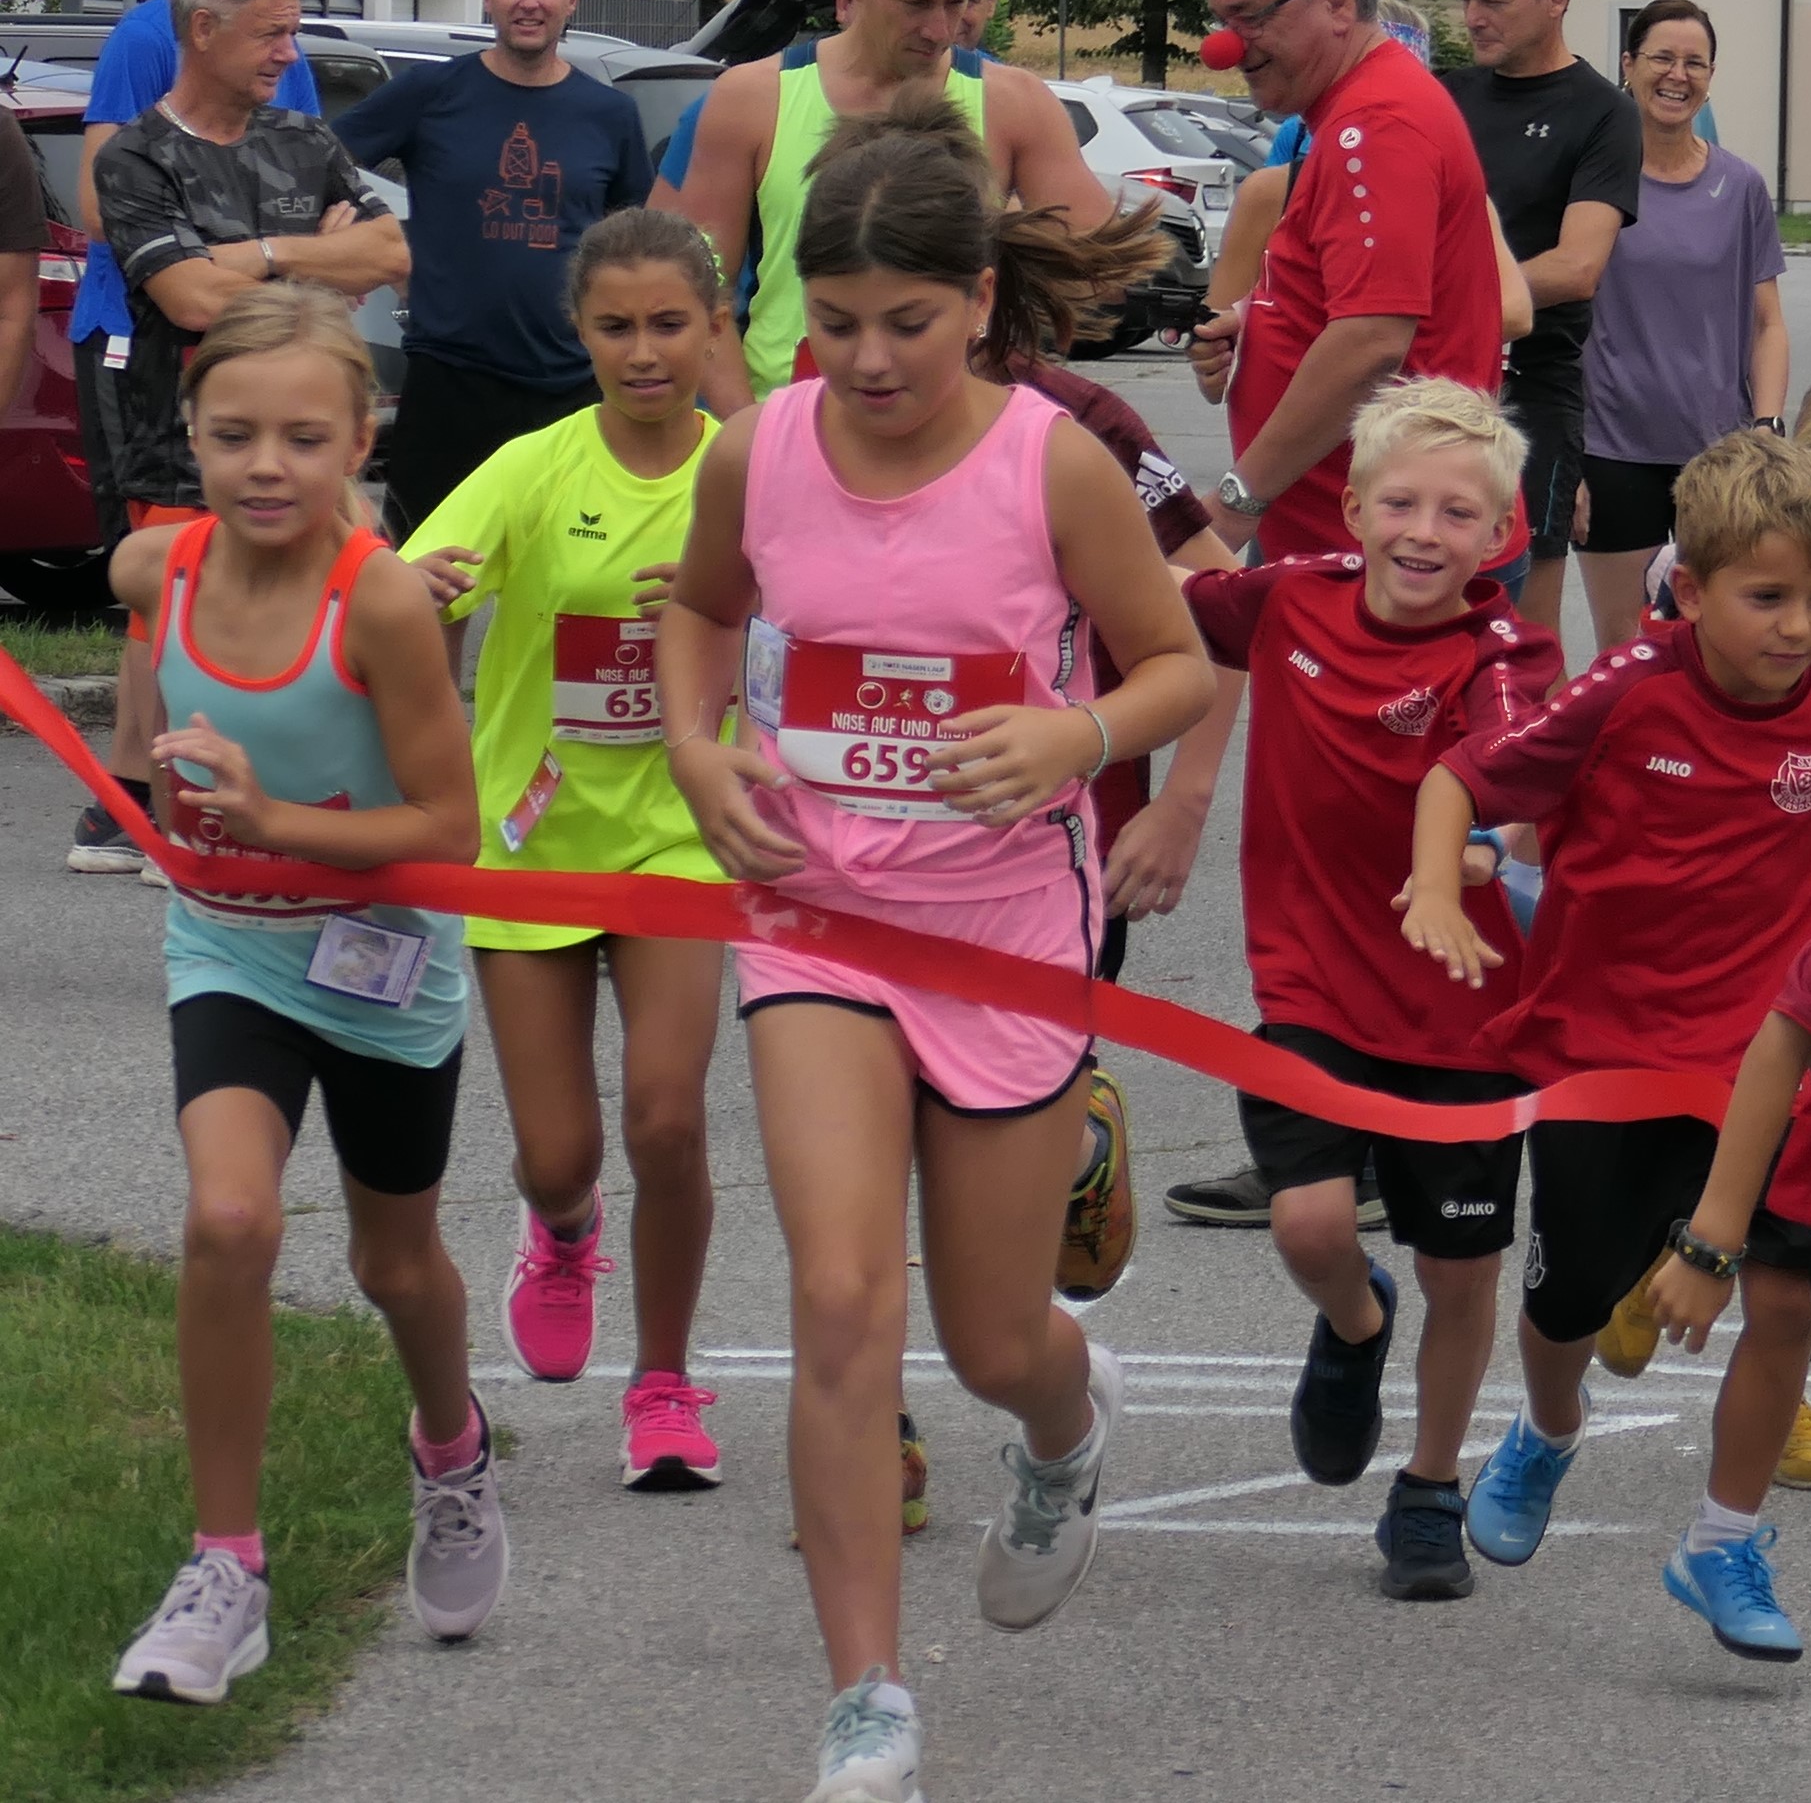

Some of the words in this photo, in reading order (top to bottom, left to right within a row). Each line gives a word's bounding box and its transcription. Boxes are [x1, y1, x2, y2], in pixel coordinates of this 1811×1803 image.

[277, 196, 315, 213] EA7
[568, 527, 607, 541] erima
[1288, 650, 1319, 678] JAKO
[596, 668, 624, 681] NASE
[628, 668, 650, 682] AUF
[832, 712, 865, 732] NASE
[871, 716, 896, 735] AUF
[902, 720, 931, 738] UND
[841, 742, 960, 786] 659
[1646, 756, 1692, 778] JAKO
[1459, 1202, 1495, 1215] JAKO
